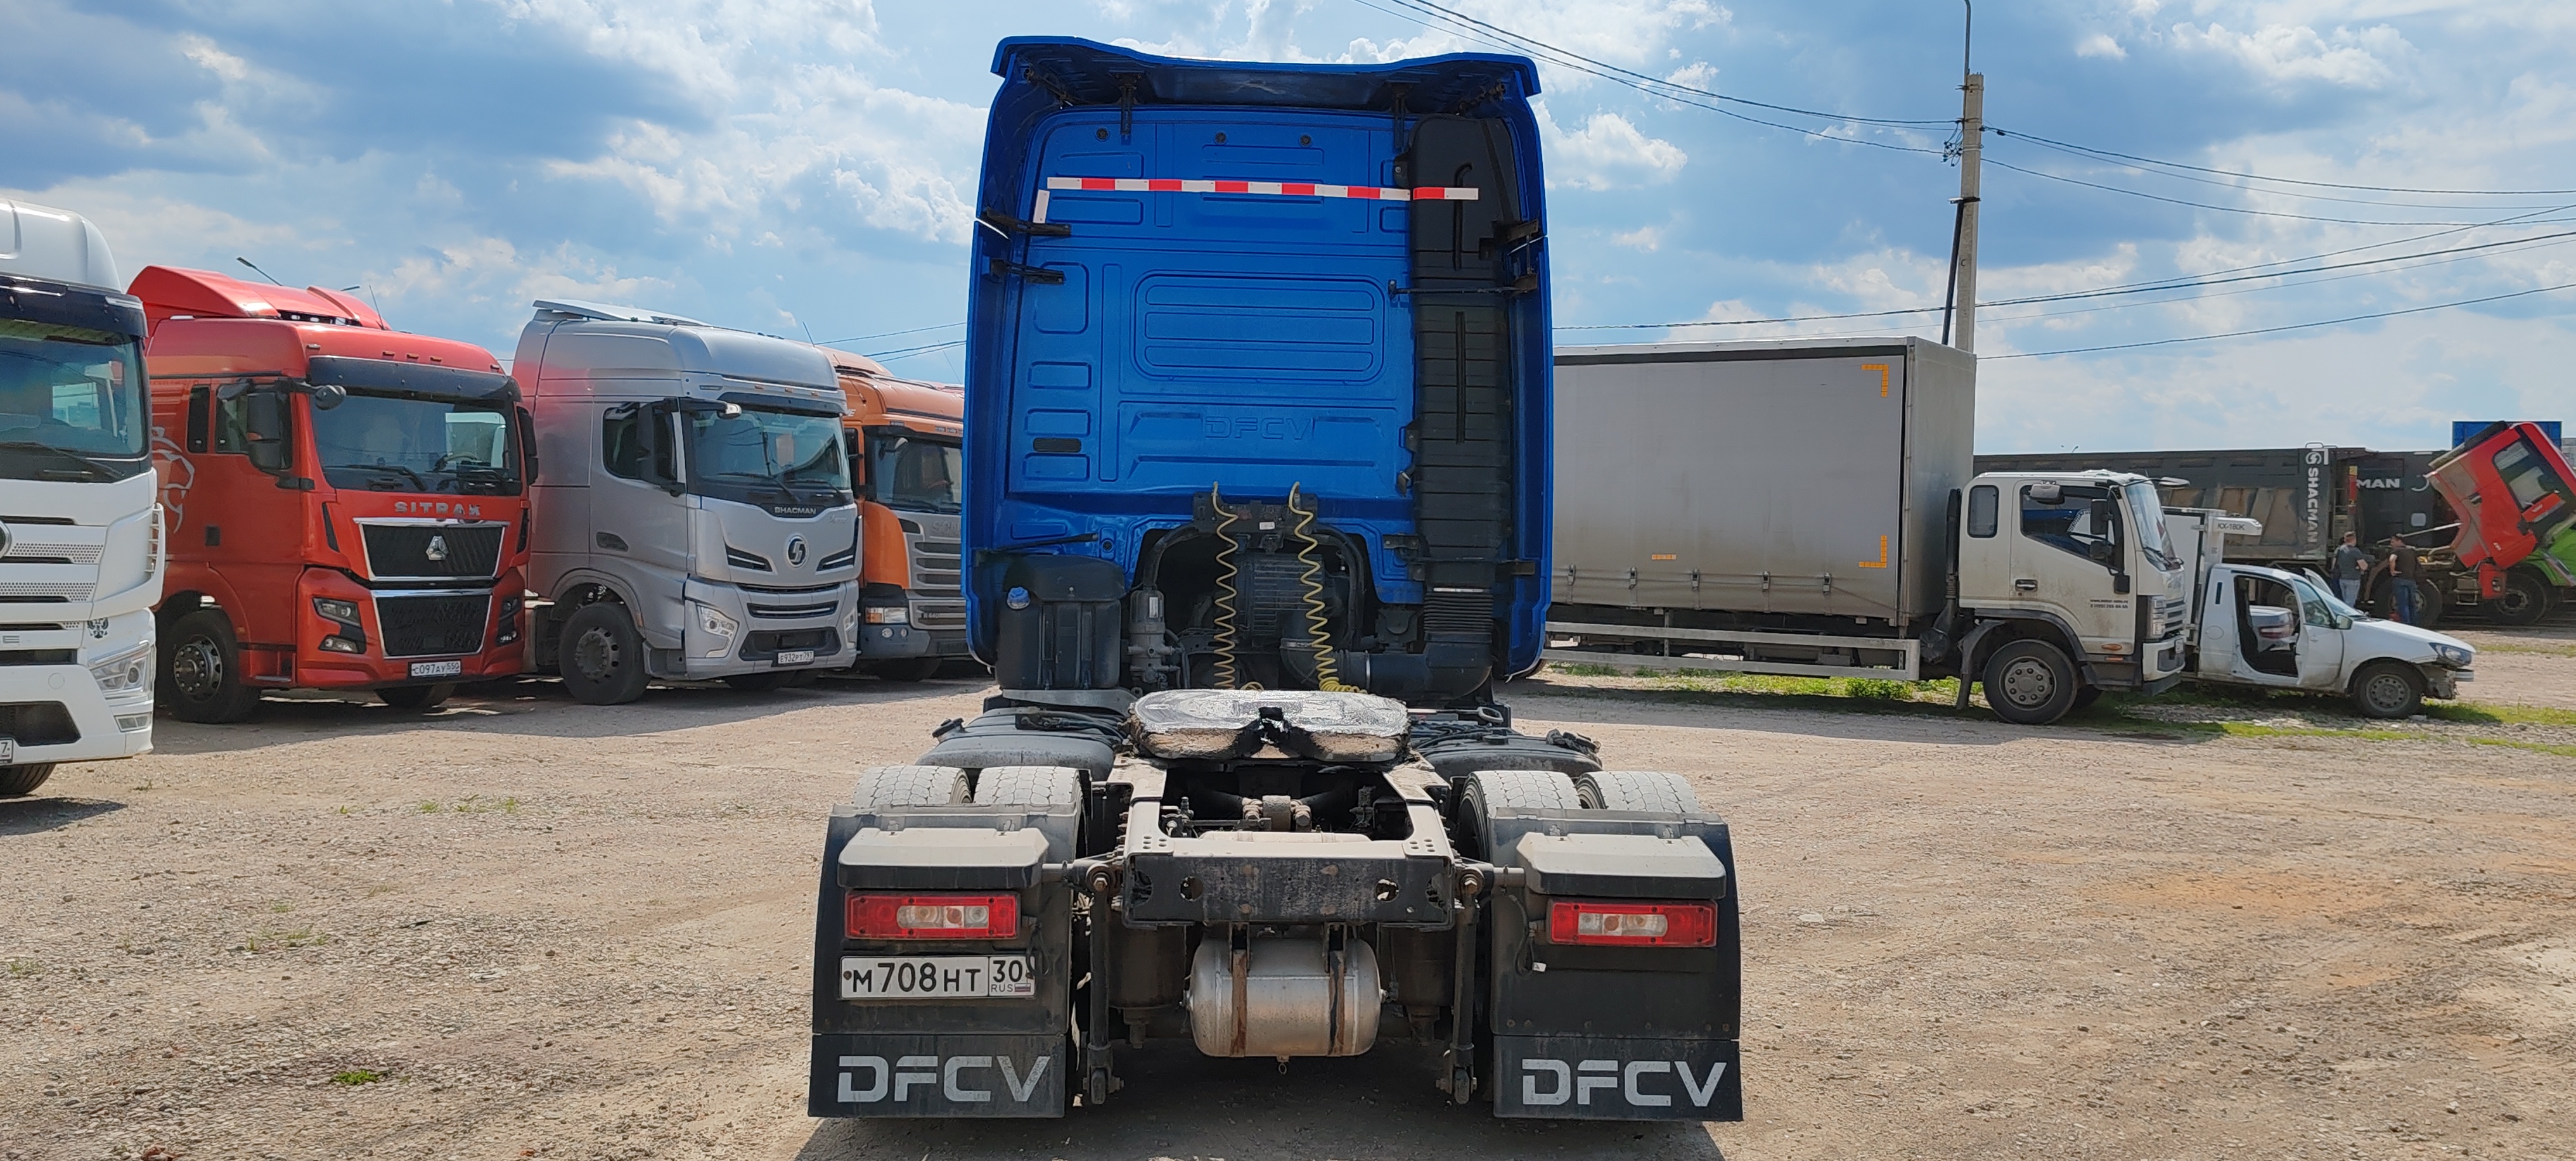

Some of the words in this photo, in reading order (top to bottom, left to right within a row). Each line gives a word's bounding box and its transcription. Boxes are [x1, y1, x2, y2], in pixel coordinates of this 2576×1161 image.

[1205, 416, 1311, 440] DFCV
[394, 501, 480, 516] SITRAK
[775, 506, 817, 515] SHACMAN
[2307, 467, 2319, 542] SHACMAN
[992, 960, 1022, 983] 30
[991, 984, 1013, 992] RUS
[837, 1056, 1051, 1103] DFCV
[1522, 1059, 1727, 1107] DFCV
